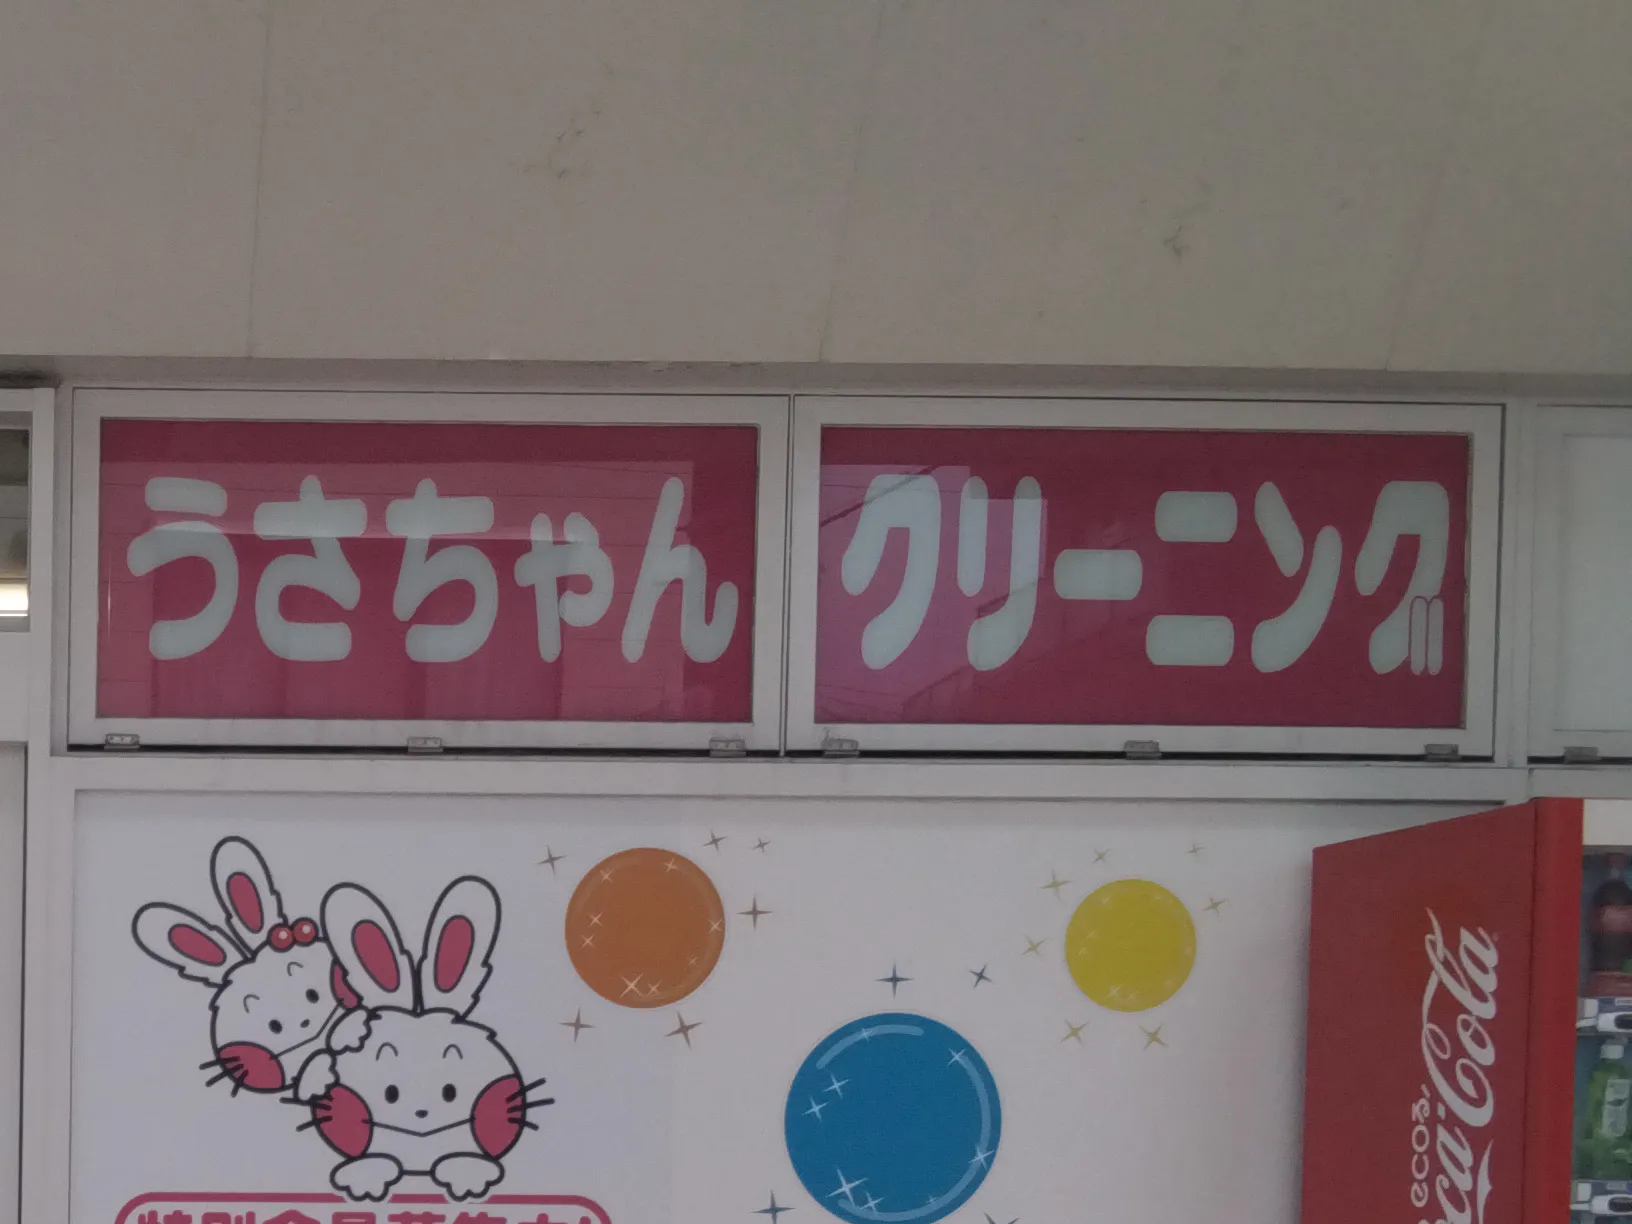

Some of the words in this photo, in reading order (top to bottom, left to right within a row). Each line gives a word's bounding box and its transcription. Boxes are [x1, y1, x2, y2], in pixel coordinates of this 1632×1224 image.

[126, 474, 739, 663] うさちゃん
[840, 472, 1451, 676] クリーニング
